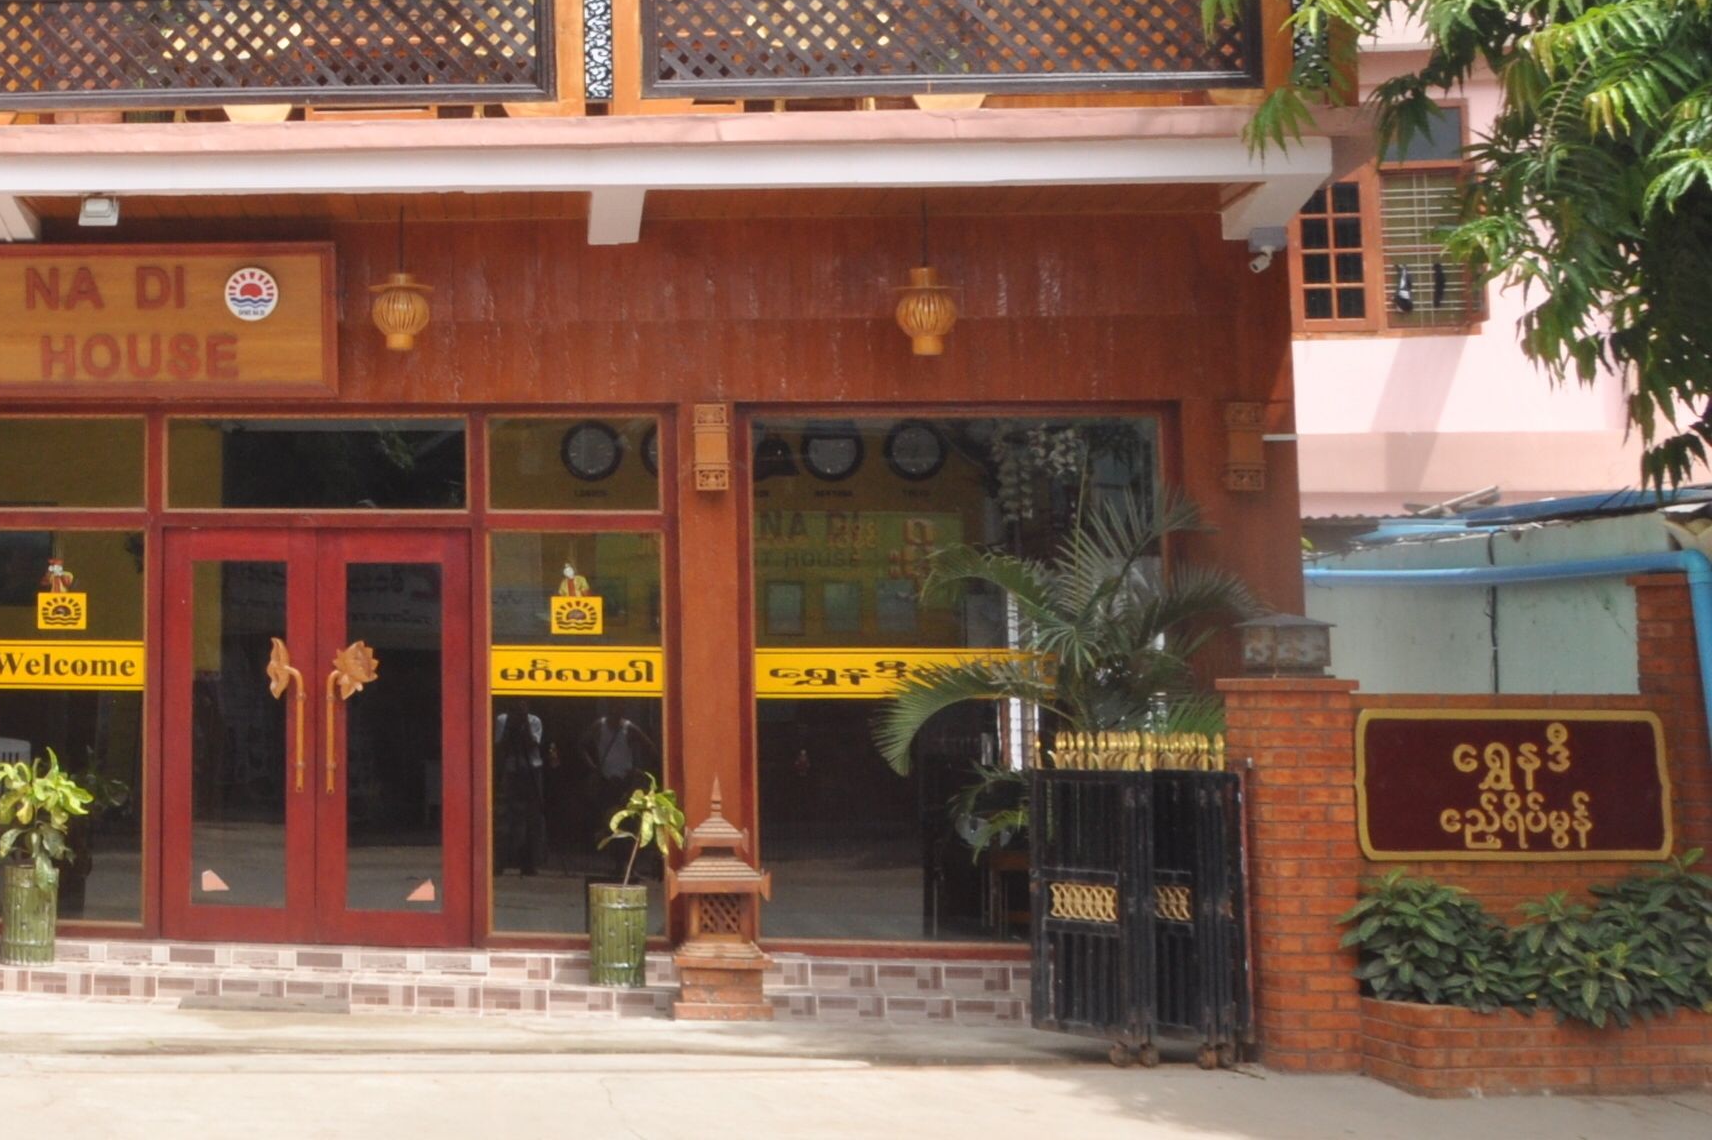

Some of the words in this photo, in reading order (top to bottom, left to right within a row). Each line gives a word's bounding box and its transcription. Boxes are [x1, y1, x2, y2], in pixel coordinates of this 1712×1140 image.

[25, 265, 105, 312] NA
[136, 264, 186, 311] DI
[40, 332, 241, 382] HOUSE
